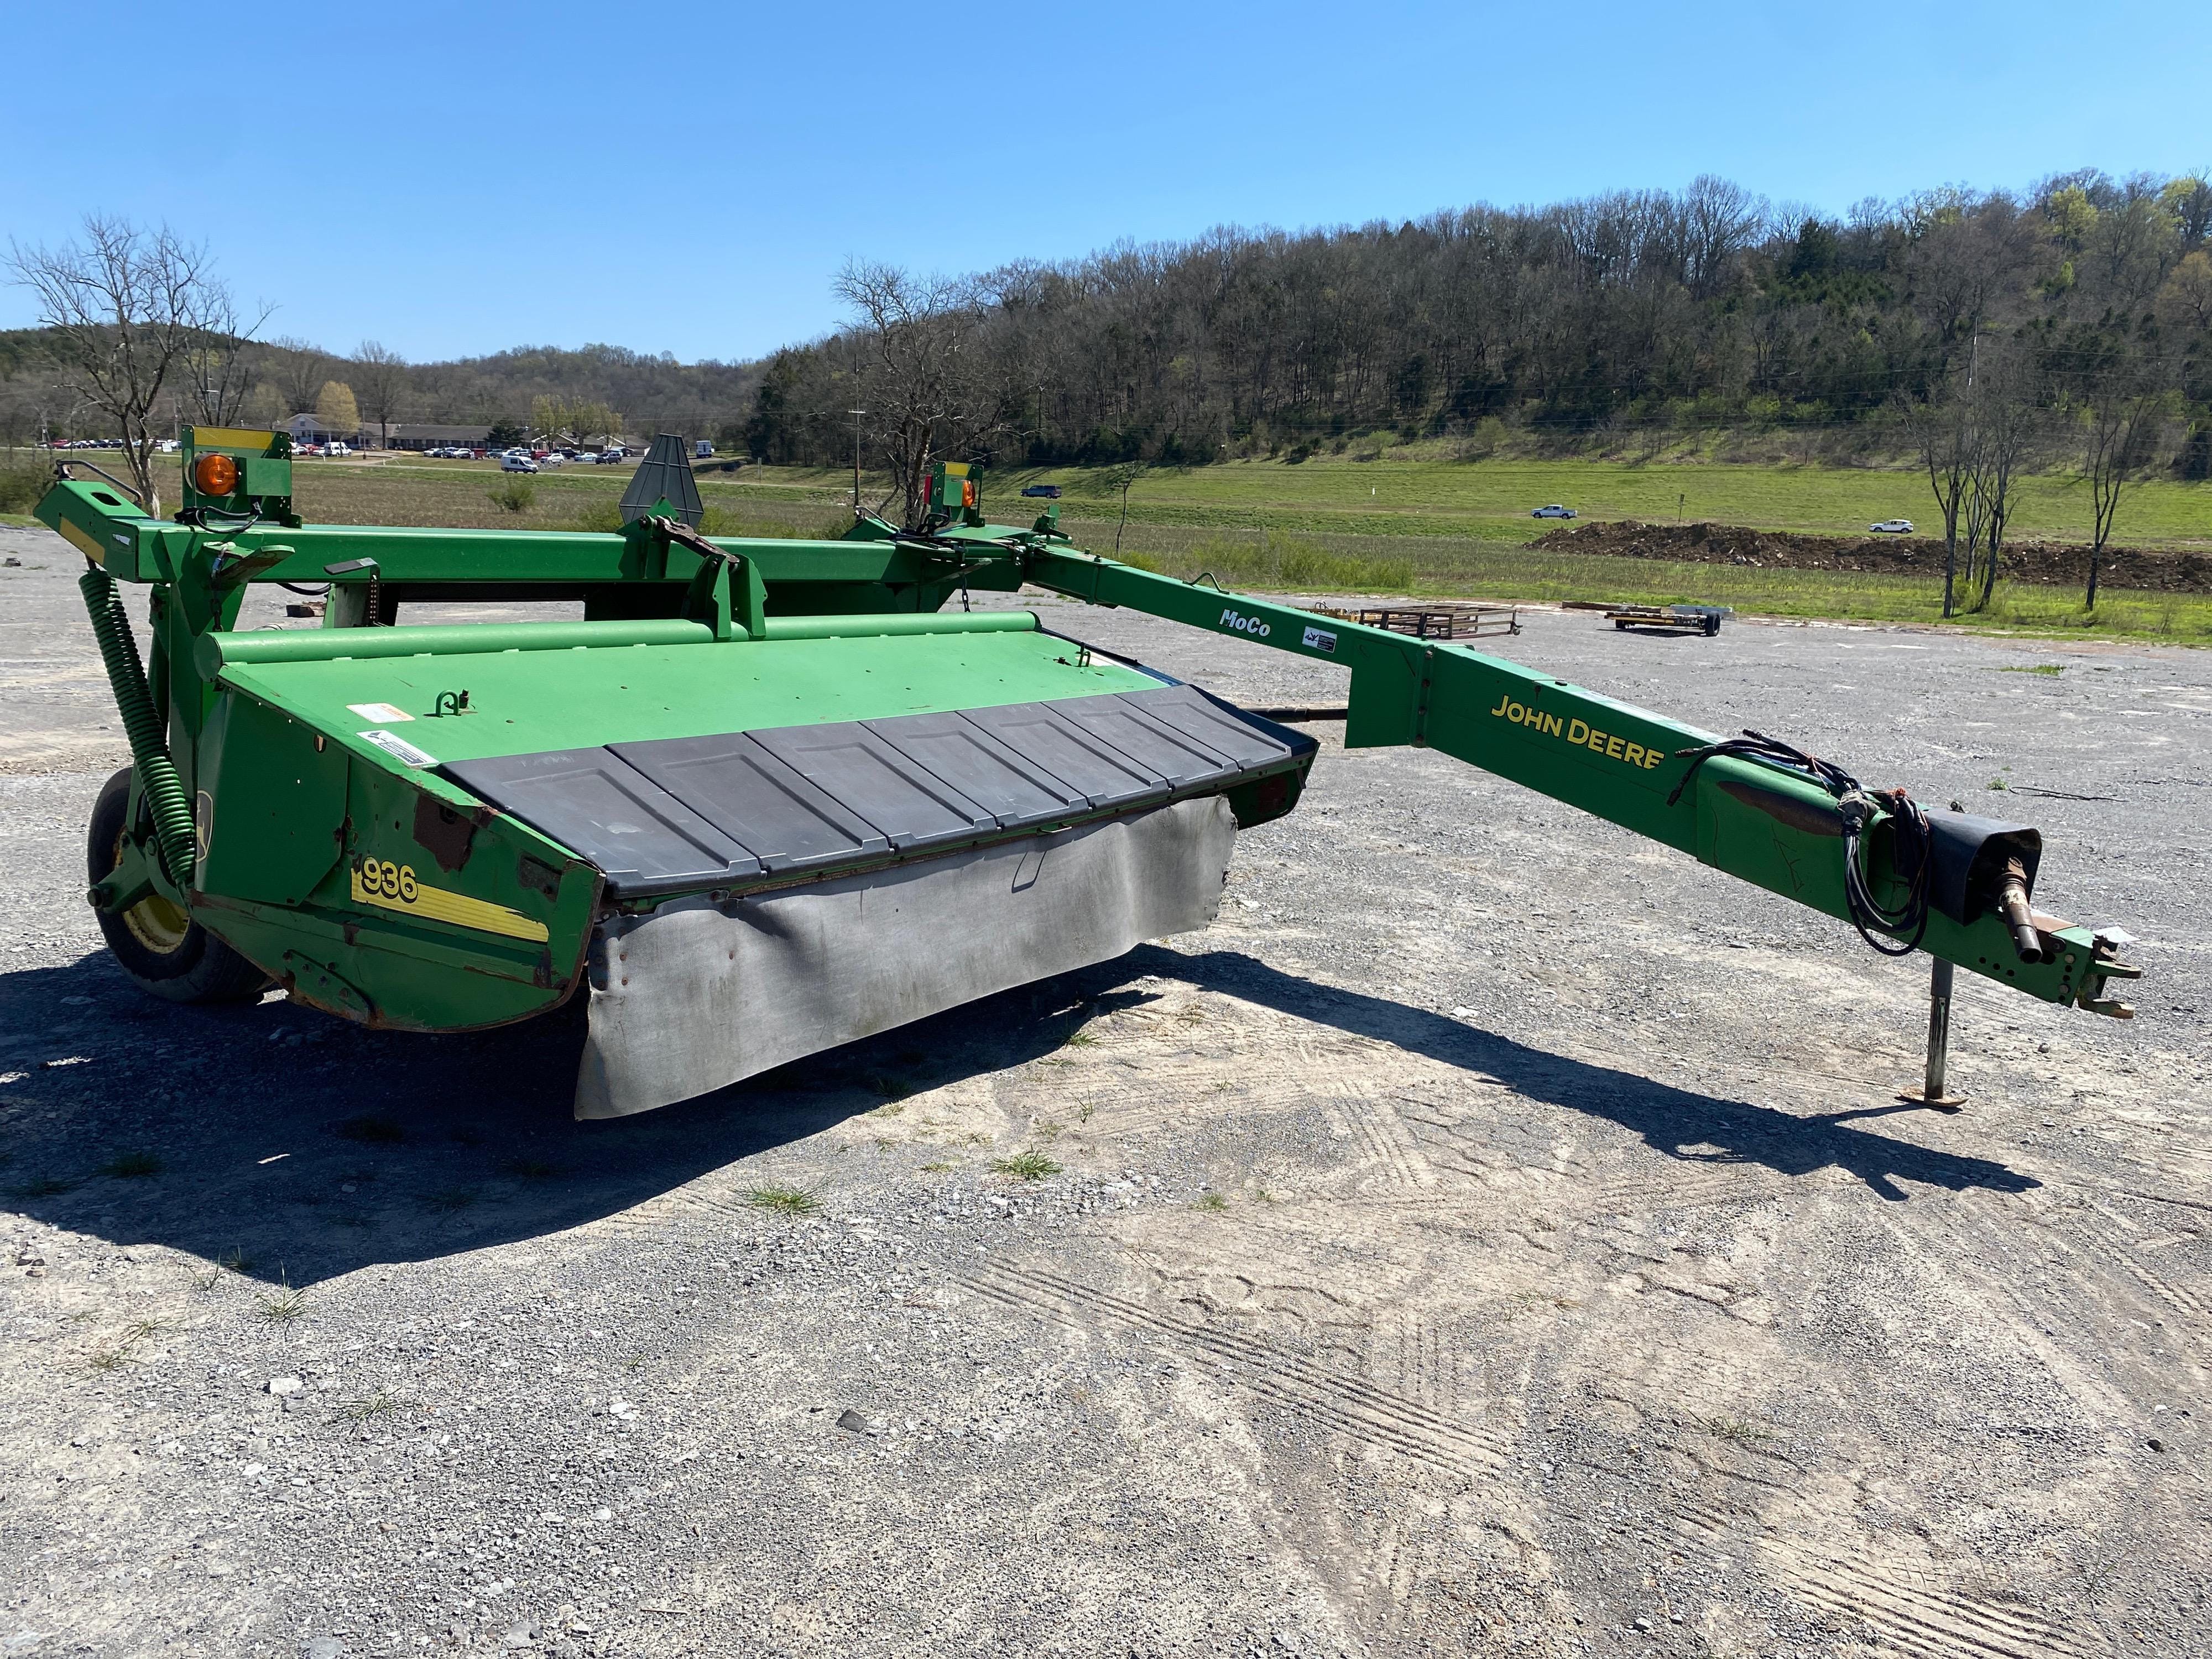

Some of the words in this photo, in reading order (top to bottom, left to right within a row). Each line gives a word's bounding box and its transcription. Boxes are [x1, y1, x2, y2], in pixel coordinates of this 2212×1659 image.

[1219, 609, 1271, 637] MoCo
[1491, 695, 1563, 738] JOHN
[1567, 718, 1665, 769] DEERE
[362, 856, 418, 901] 936
